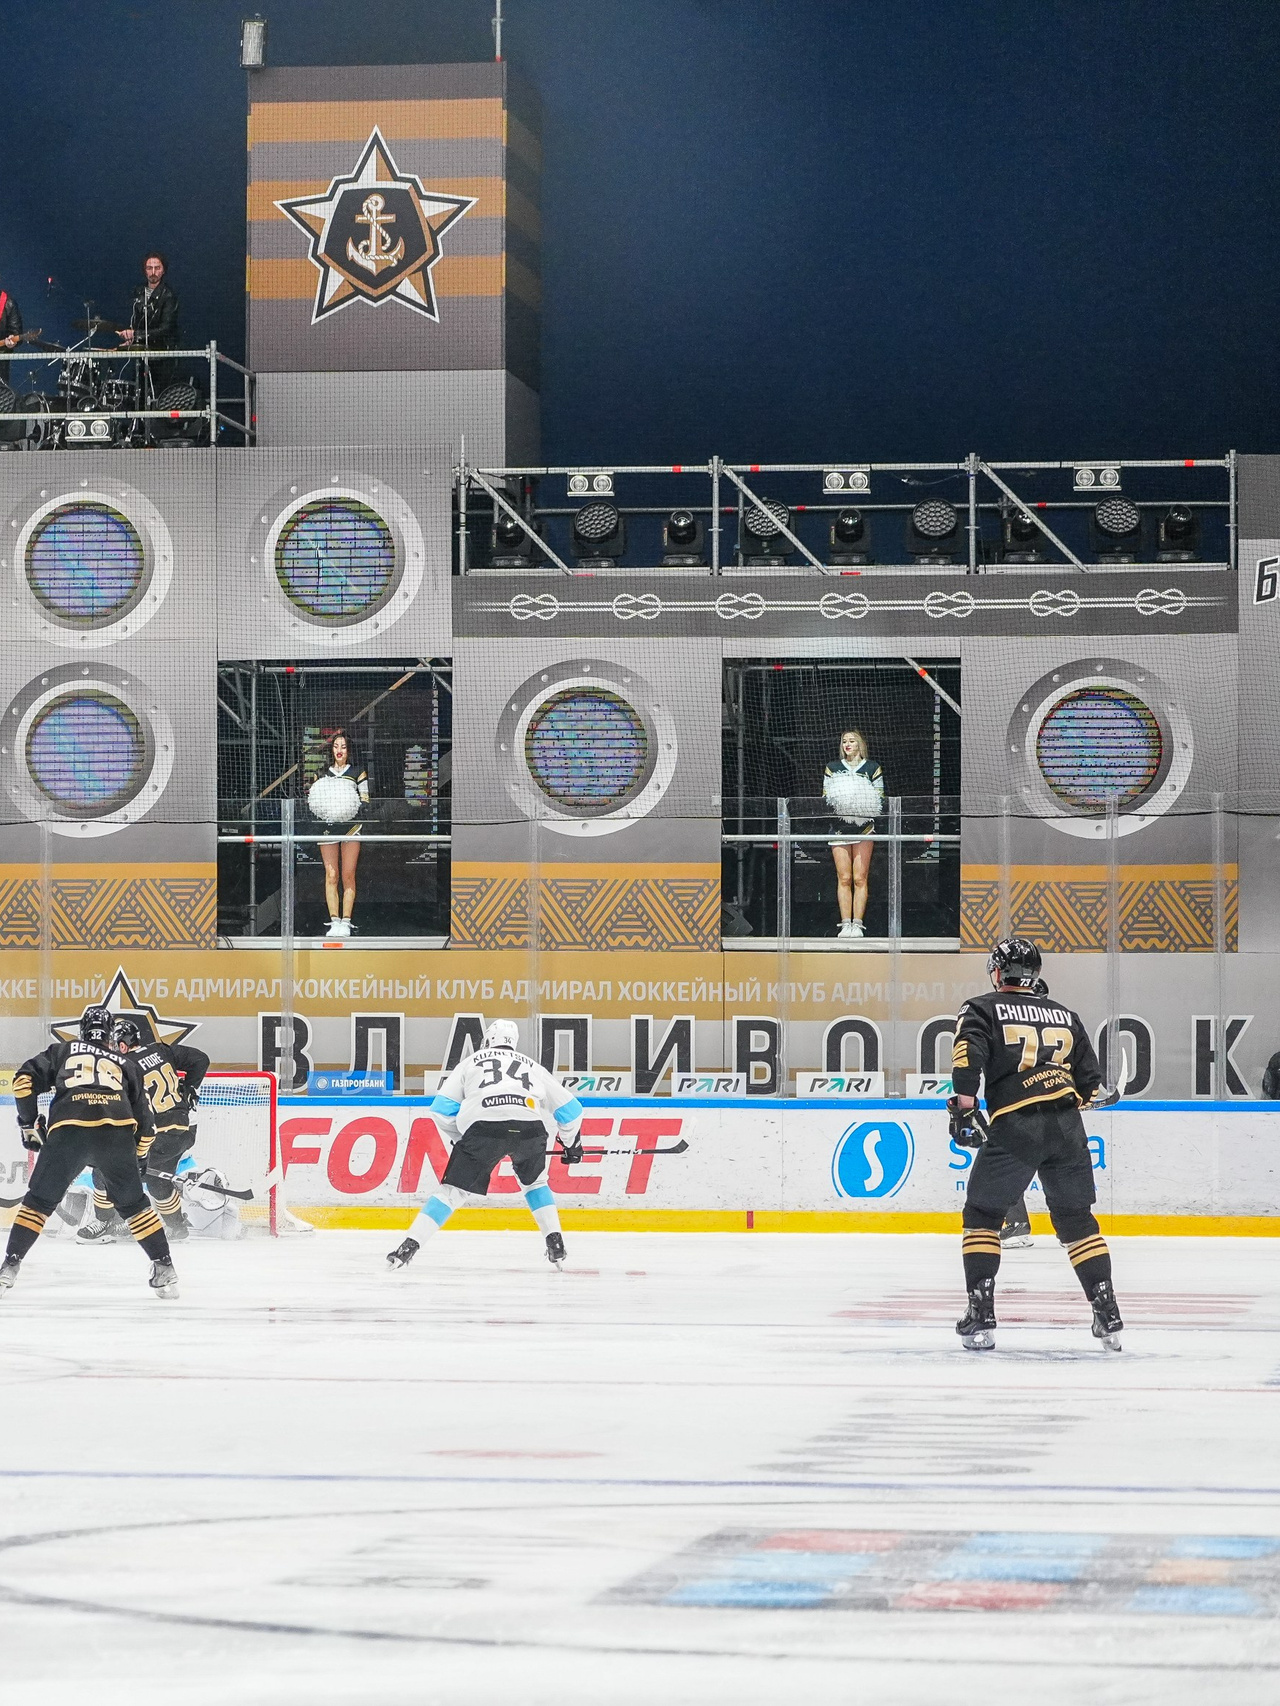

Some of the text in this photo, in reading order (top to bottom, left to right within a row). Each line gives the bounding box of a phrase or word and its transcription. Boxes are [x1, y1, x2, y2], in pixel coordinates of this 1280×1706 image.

[174, 978, 282, 1001] АДМИРАЛ
[293, 974, 431, 999] ХОККЕЙНЫЙ
[437, 979, 495, 999] КЛУБ
[500, 979, 612, 1003] АДМИРАЛ
[617, 977, 760, 1002] ХОККЕЙНЫЙ
[1020, 978, 1032, 986] 73
[995, 1004, 1072, 1026] CHUDINOV
[90, 1030, 102, 1040] 32
[503, 1036, 512, 1044] 34
[70, 1042, 127, 1066] BERLYOV
[257, 1011, 1256, 1100] ВЛАДИВООК
[473, 1050, 534, 1068] KUZNETSOV
[475, 1058, 534, 1091] 34
[143, 1062, 182, 1113] 20
[331, 1078, 385, 1090] ГАЗПРОМБАНК
[562, 1077, 622, 1092] PARI
[678, 1078, 740, 1093] PARI
[809, 1078, 872, 1093] PARI
[72, 1093, 121, 1102] ПРИМОРСКИЙ
[485, 1096, 523, 1107] Winline
[278, 1116, 683, 1195] FONET
